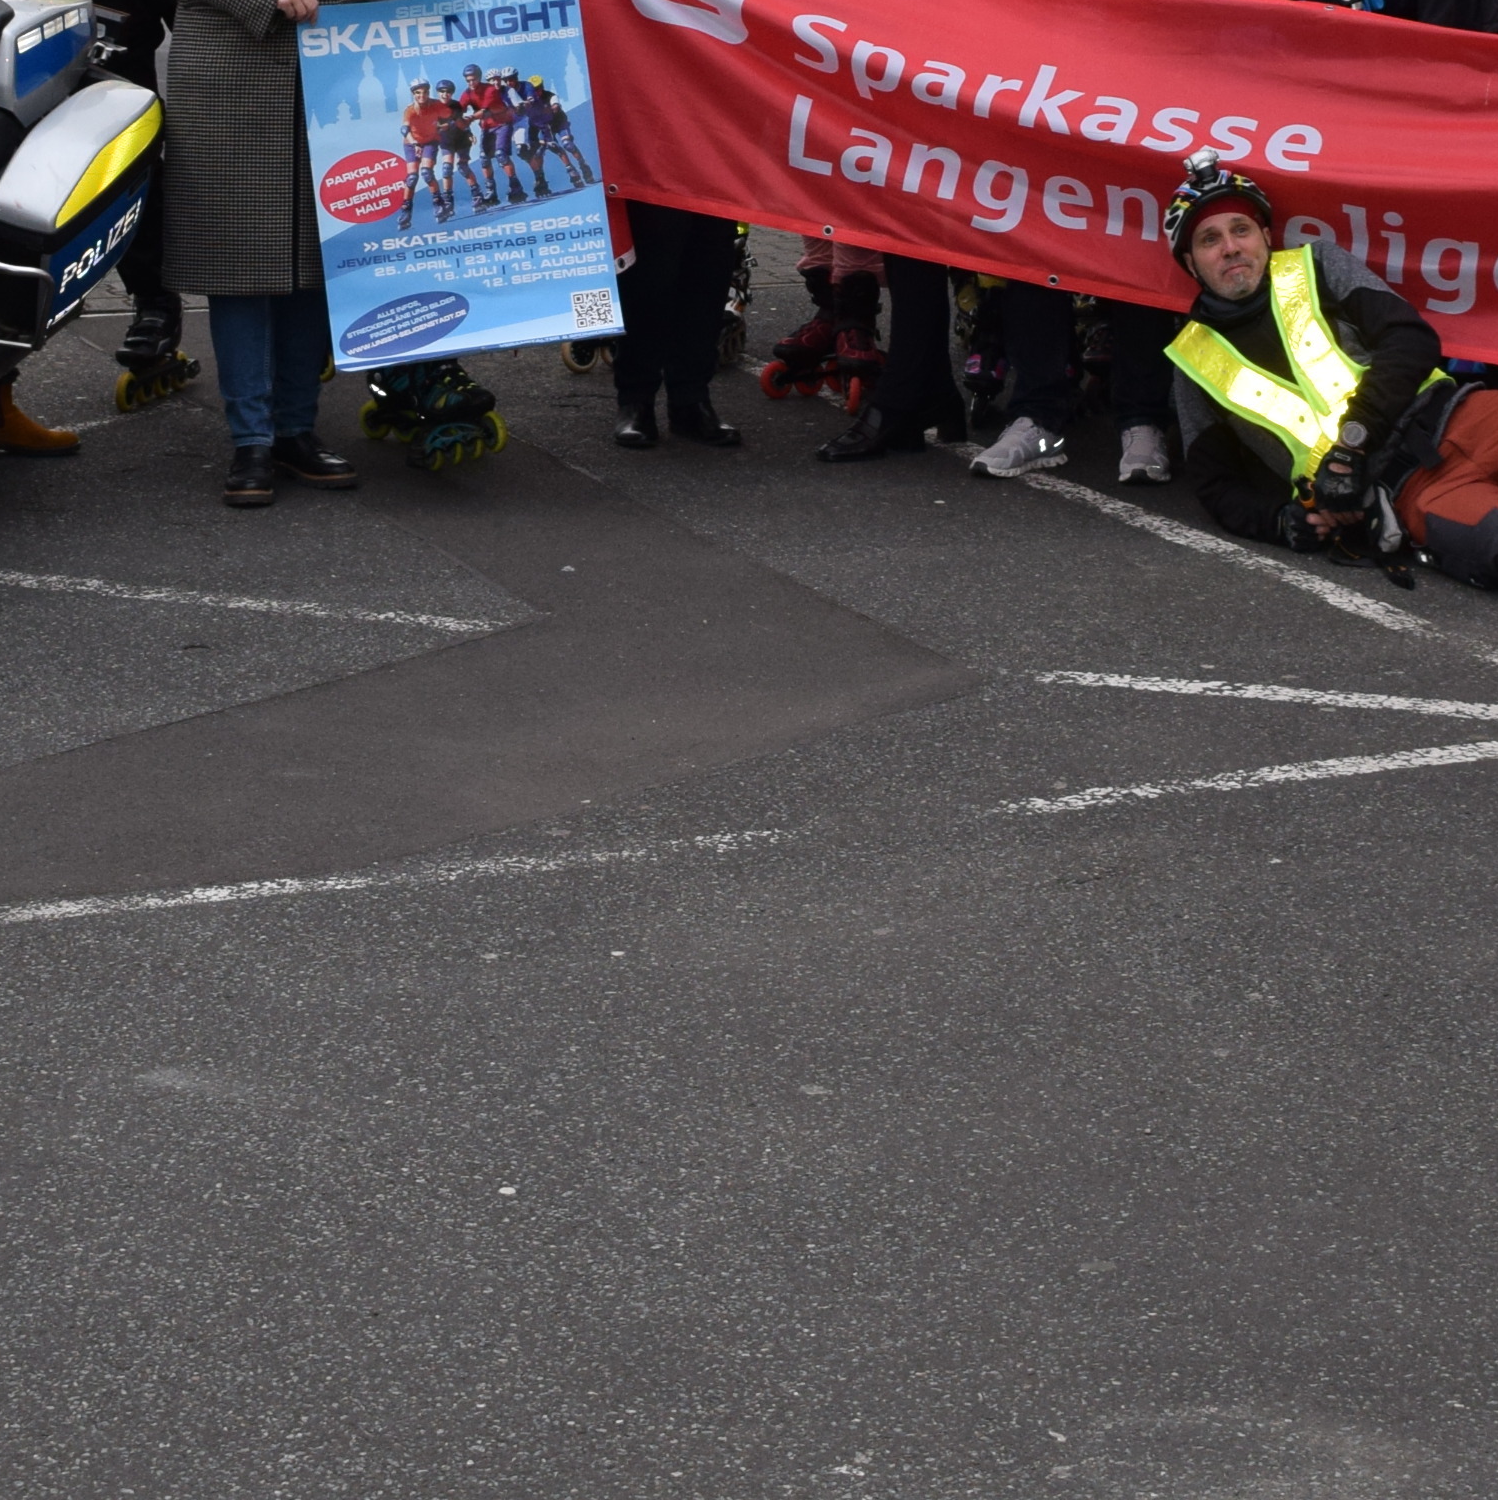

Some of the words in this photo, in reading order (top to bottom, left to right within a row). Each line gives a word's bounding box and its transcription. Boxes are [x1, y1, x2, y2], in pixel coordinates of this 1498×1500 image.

[392, 47, 420, 59] DER
[422, 41, 467, 56] SUPER
[469, 28, 579, 50] FAMILIENSPASS!
[792, 14, 1323, 172] Sparkasse
[325, 157, 399, 187] PARKPLATZ
[356, 177, 377, 191] AM
[355, 198, 392, 217] HAUS
[59, 197, 142, 294] POLIZEI
[337, 252, 406, 269] JEWEILS
[414, 236, 537, 259] DONNERSTAGS
[544, 232, 566, 243] 20
[570, 227, 604, 240] UHR
[382, 222, 527, 250] SKATE-NIGHTS
[374, 266, 401, 277] 25.
[405, 260, 452, 273] APRIL
[465, 254, 491, 265] 23.
[494, 250, 525, 261] MAI
[538, 245, 564, 256] 20.
[568, 239, 606, 252] JUNI
[434, 271, 459, 281] 18.
[462, 266, 497, 278] JULI
[511, 261, 536, 272] 15.
[541, 252, 607, 268] AUGUST
[482, 277, 508, 288] 12.
[511, 264, 609, 285] SEPTEMBER
[347, 311, 411, 339] STRECKENPLÄNE
[412, 306, 429, 316] UND
[429, 296, 456, 310] BILDER
[377, 308, 395, 320] ALLE
[369, 325, 397, 339] FINDET
[397, 321, 411, 330] IHR
